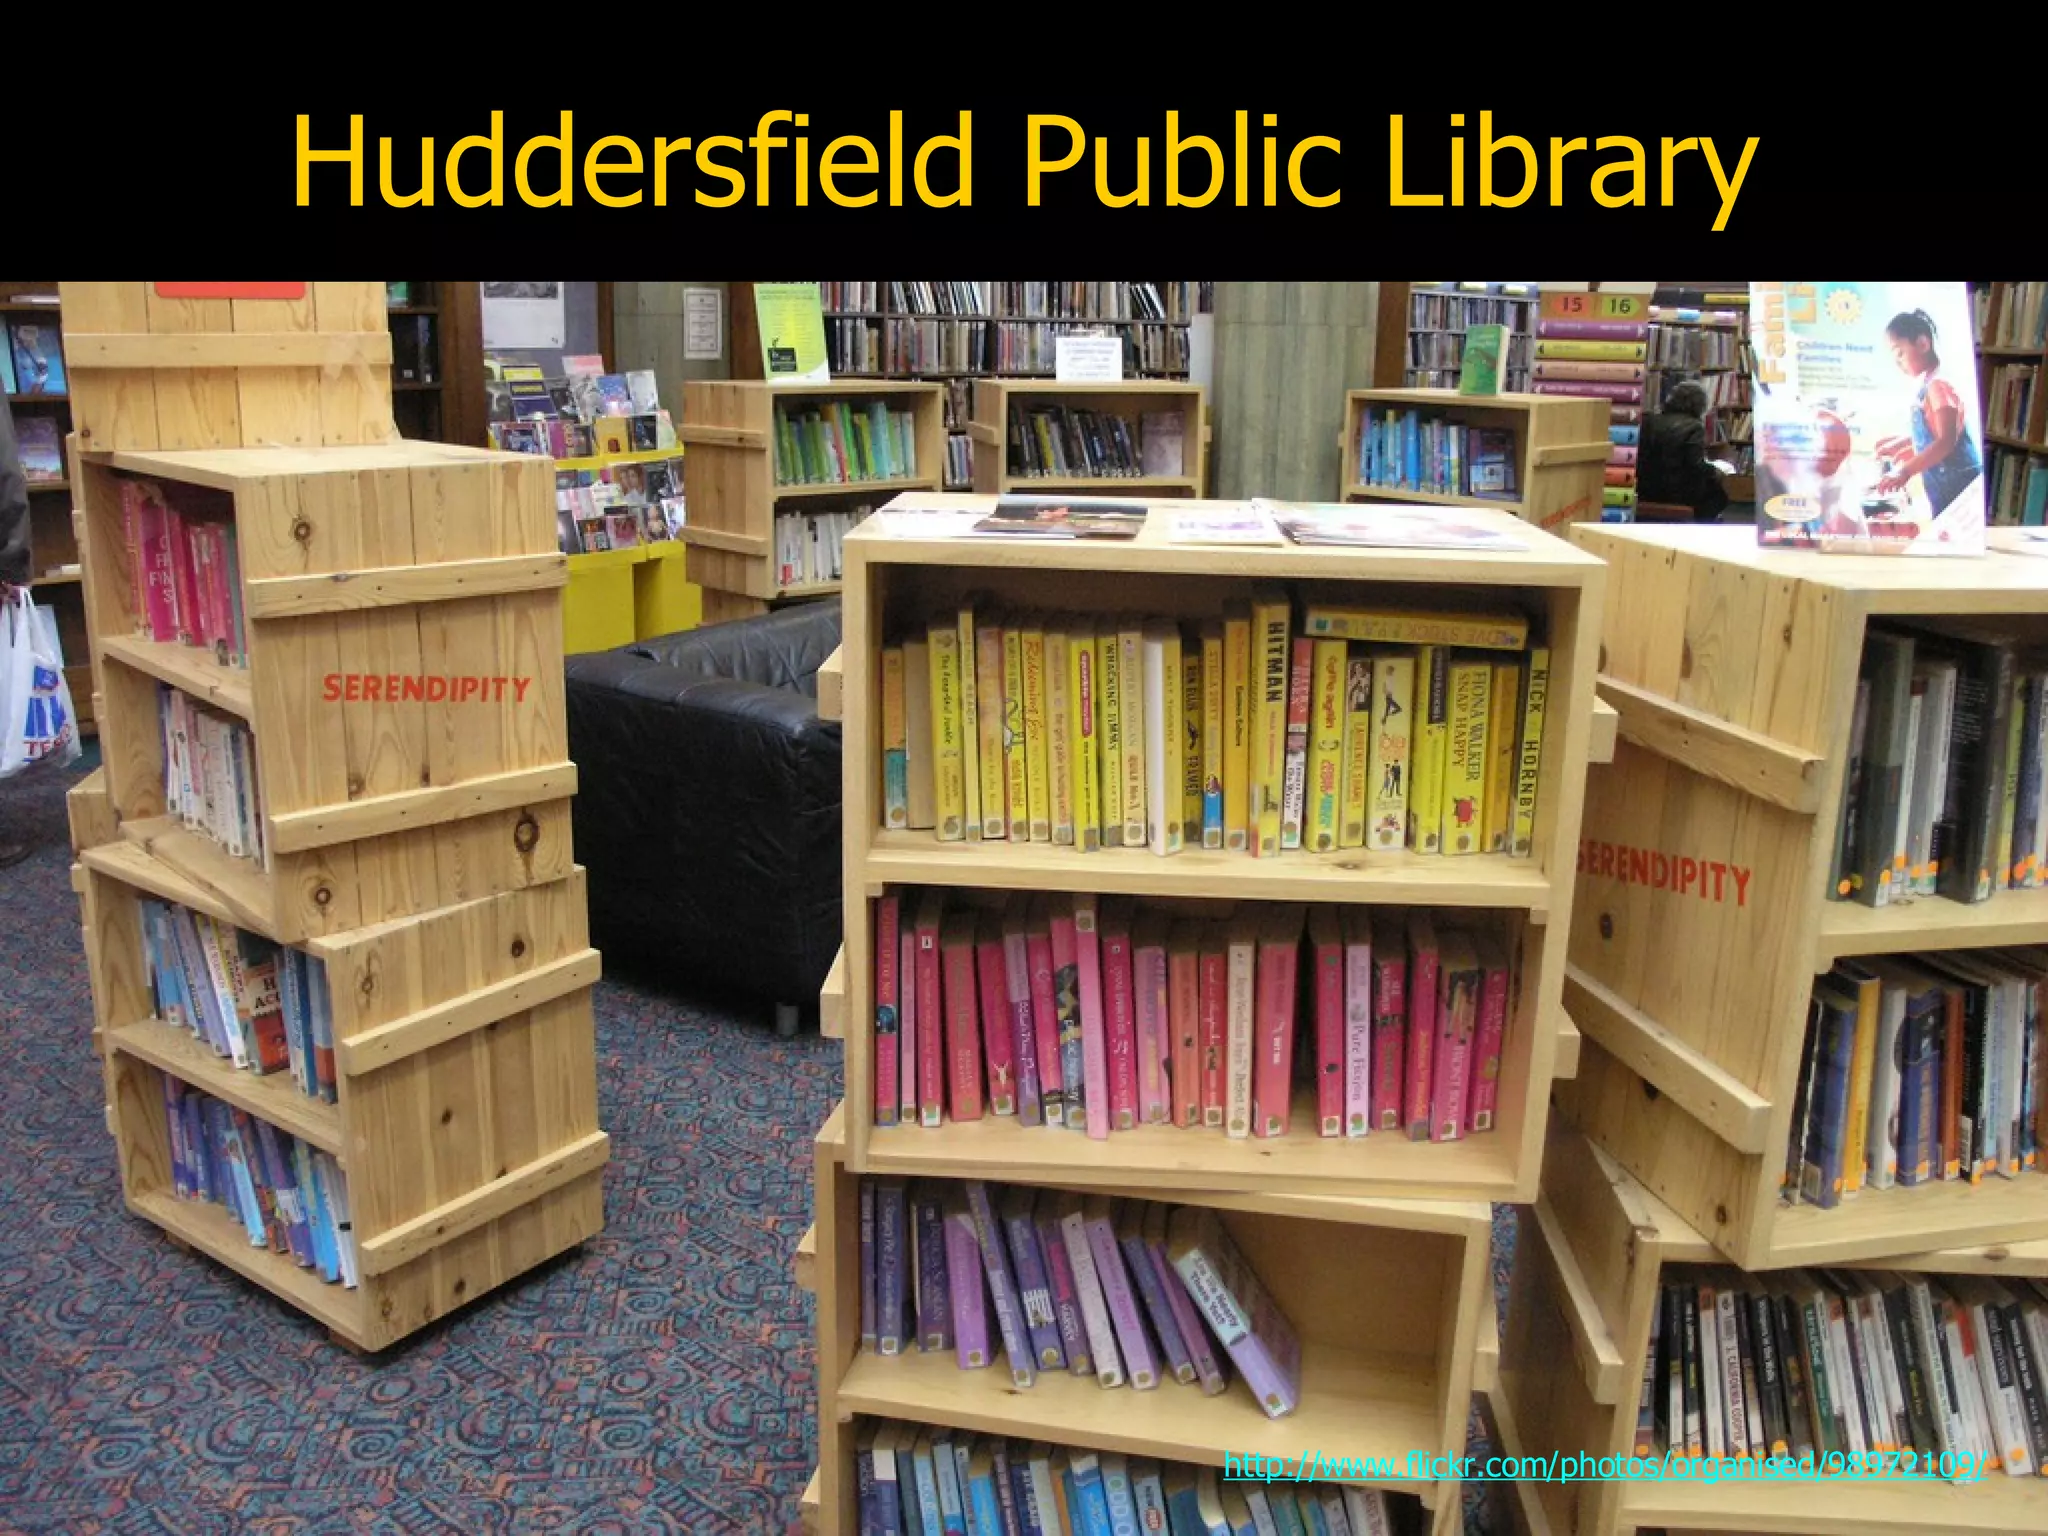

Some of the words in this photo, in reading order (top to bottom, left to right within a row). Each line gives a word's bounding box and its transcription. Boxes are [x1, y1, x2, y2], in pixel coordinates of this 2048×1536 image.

[1563, 297, 1583, 312] 15
[1611, 298, 1631, 314] 16
[1266, 621, 1285, 703] HITMAN
[322, 674, 531, 703] SERENDIPITY
[1457, 672, 1469, 712] SNAP
[1471, 670, 1486, 719] FIONA
[1530, 669, 1548, 713] NICK
[1452, 717, 1467, 768] HAPPY
[1466, 723, 1484, 782] WALKER
[1519, 739, 1540, 820] HORNBY
[1351, 1025, 1364, 1053] Pure
